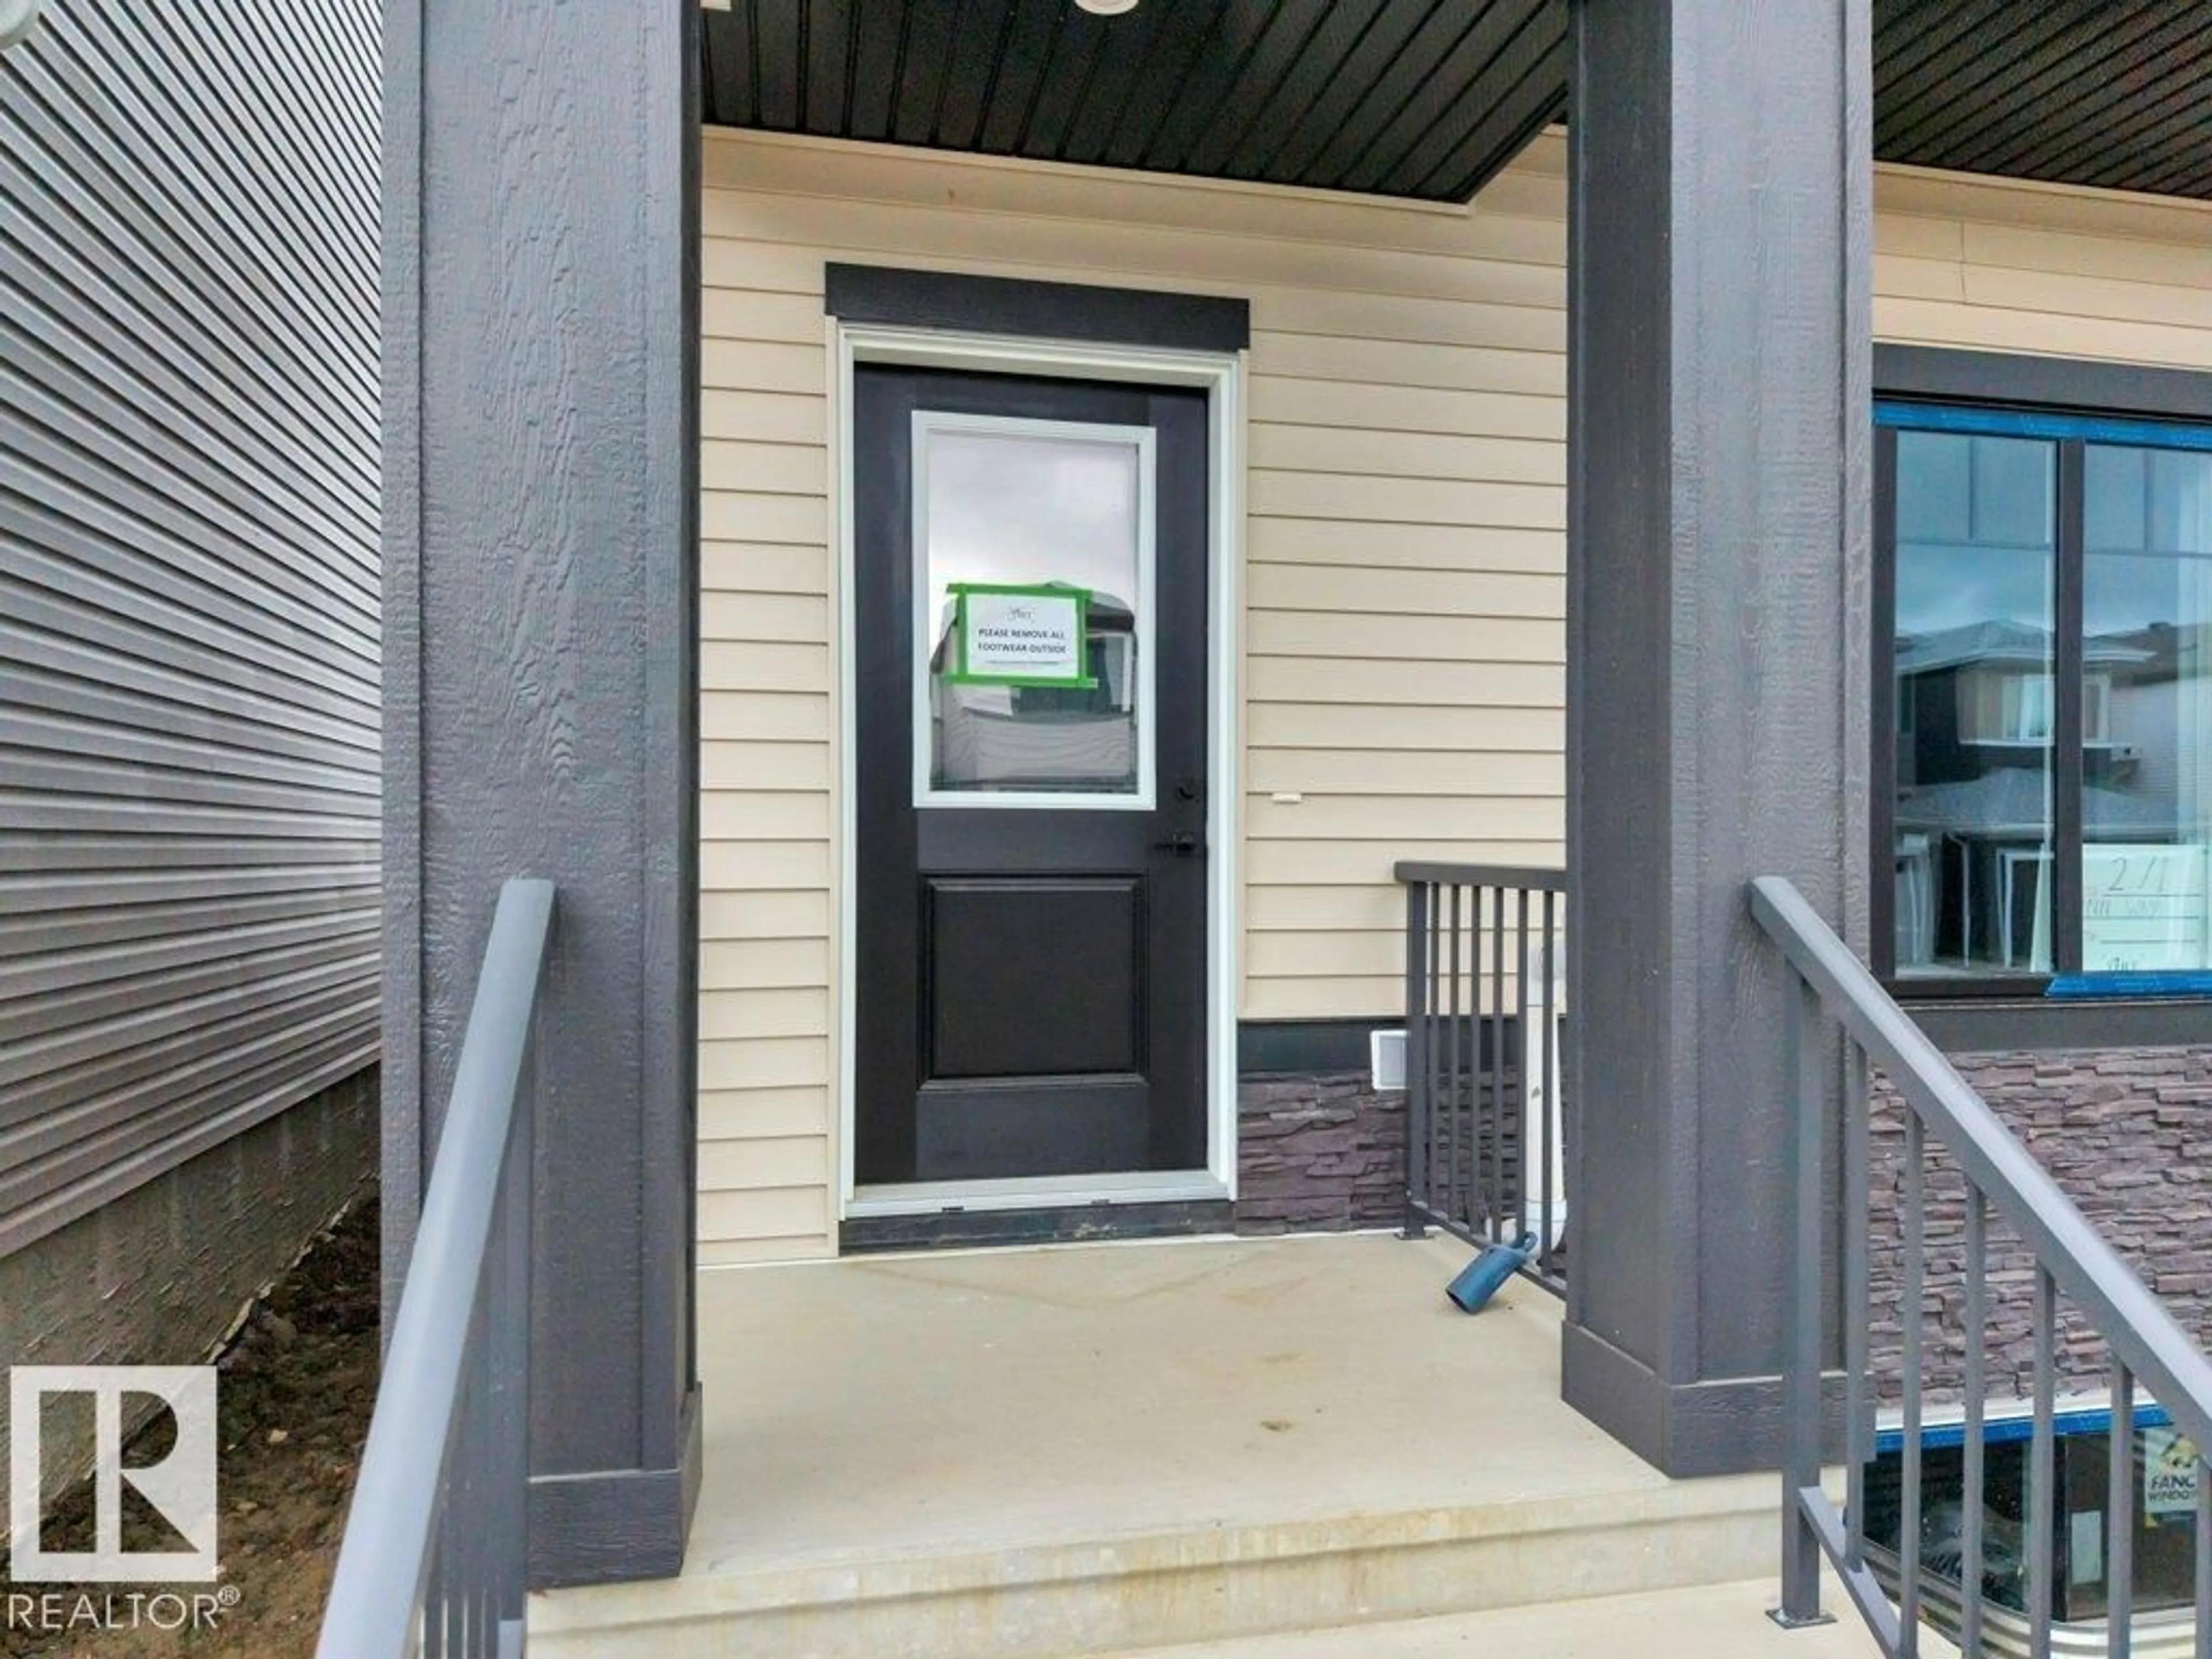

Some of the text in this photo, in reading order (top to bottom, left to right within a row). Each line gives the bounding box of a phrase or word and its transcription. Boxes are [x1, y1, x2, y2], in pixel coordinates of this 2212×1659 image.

[978, 628, 1065, 639] PLEASE REMOVE ALL
[978, 642, 1066, 654] FOOTWEAR OUTSIDE
[2150, 1474, 2195, 1490] FANC
[2147, 1490, 2196, 1502] WINDO
